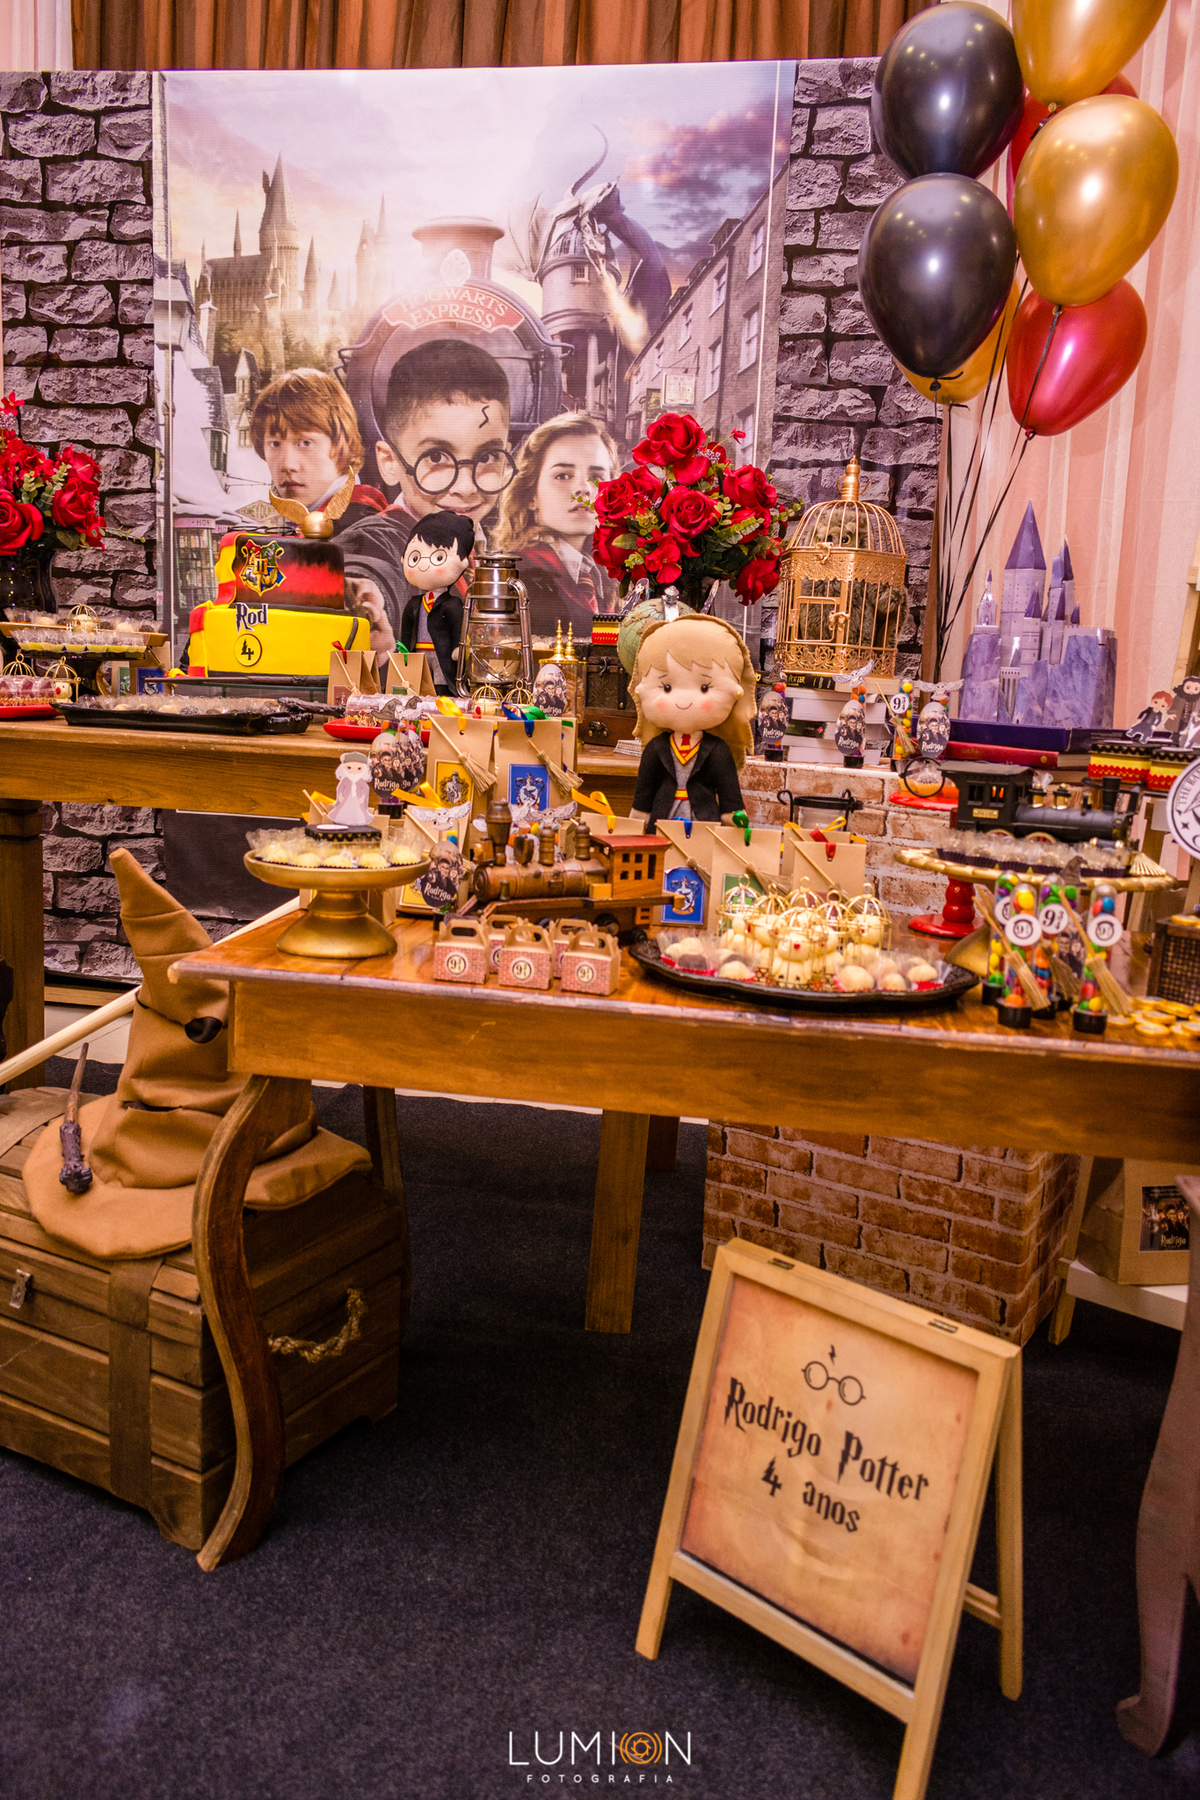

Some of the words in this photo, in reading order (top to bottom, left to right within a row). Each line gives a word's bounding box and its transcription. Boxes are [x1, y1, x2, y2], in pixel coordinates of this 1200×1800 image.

[400, 288, 508, 317] HOGWARTS
[410, 304, 496, 328] EXPRESS
[235, 602, 269, 635] Rod
[240, 638, 255, 661] 4
[763, 727, 784, 739] Rodrigo
[838, 738, 859, 749] Rodrigo
[922, 741, 944, 752] Rodrigo
[374, 777, 400, 791] Rodrigo
[424, 882, 452, 901] Rodrigo
[724, 1377, 821, 1458] Rodrigo
[837, 1430, 929, 1500] Potter
[761, 1456, 782, 1497] 4
[803, 1481, 860, 1533] anos
